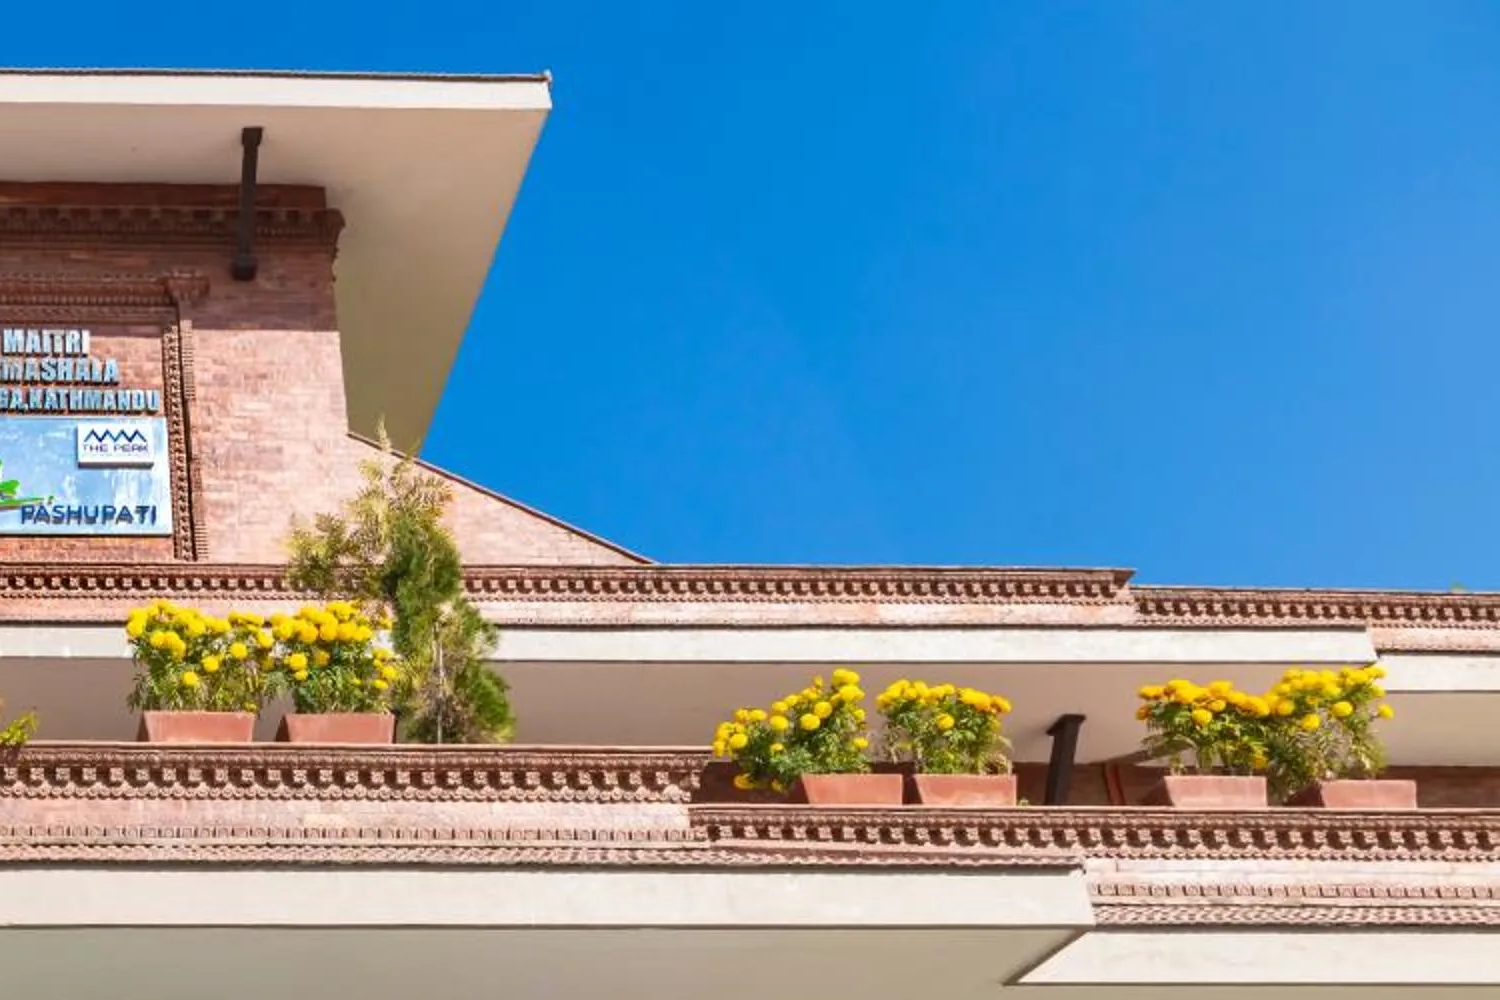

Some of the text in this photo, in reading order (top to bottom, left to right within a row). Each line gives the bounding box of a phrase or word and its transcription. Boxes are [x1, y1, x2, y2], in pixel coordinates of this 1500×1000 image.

[2, 328, 90, 355] MAITRI
[83, 443, 149, 453] THE PEAK
[20, 504, 158, 526] PASHUPATI
